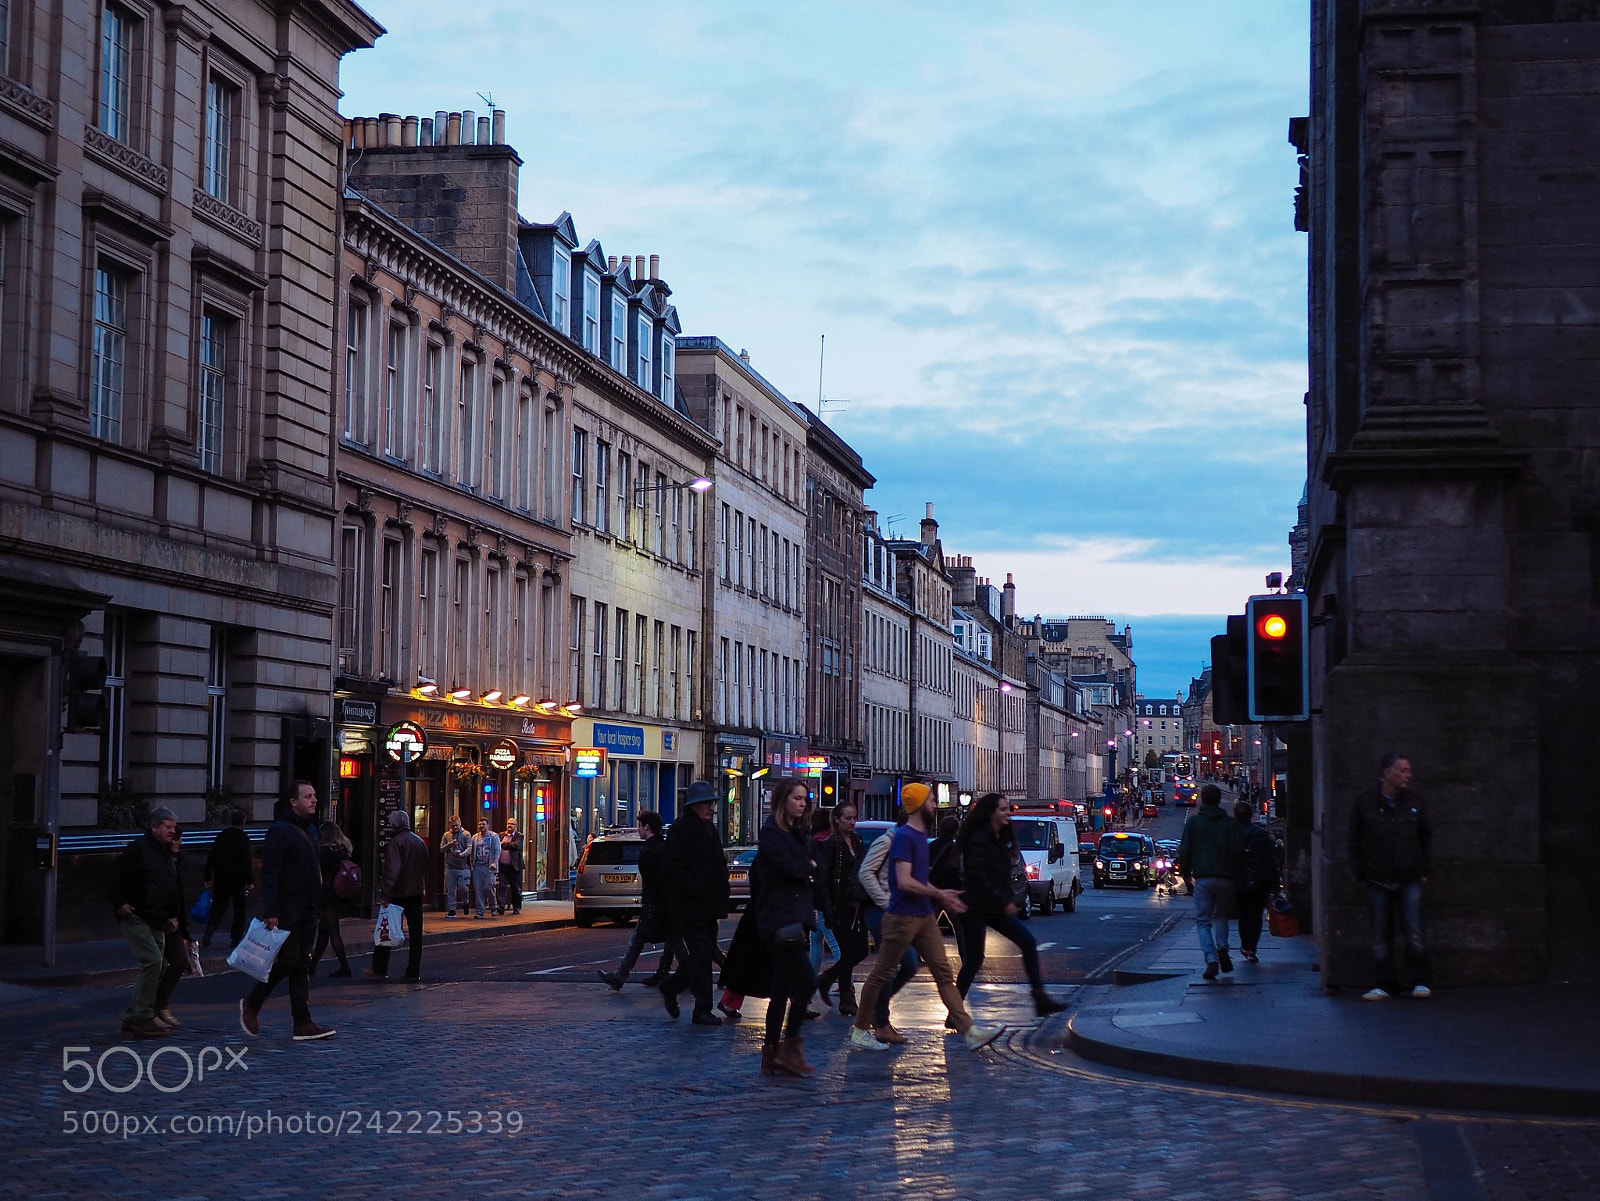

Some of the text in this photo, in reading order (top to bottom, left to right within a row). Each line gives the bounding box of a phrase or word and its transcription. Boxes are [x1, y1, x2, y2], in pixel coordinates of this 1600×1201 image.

[418, 708, 449, 728] PIZZA
[452, 712, 502, 731] PARADISE
[597, 728, 642, 750] Your local hospice shop
[494, 748, 511, 756] PIZZA
